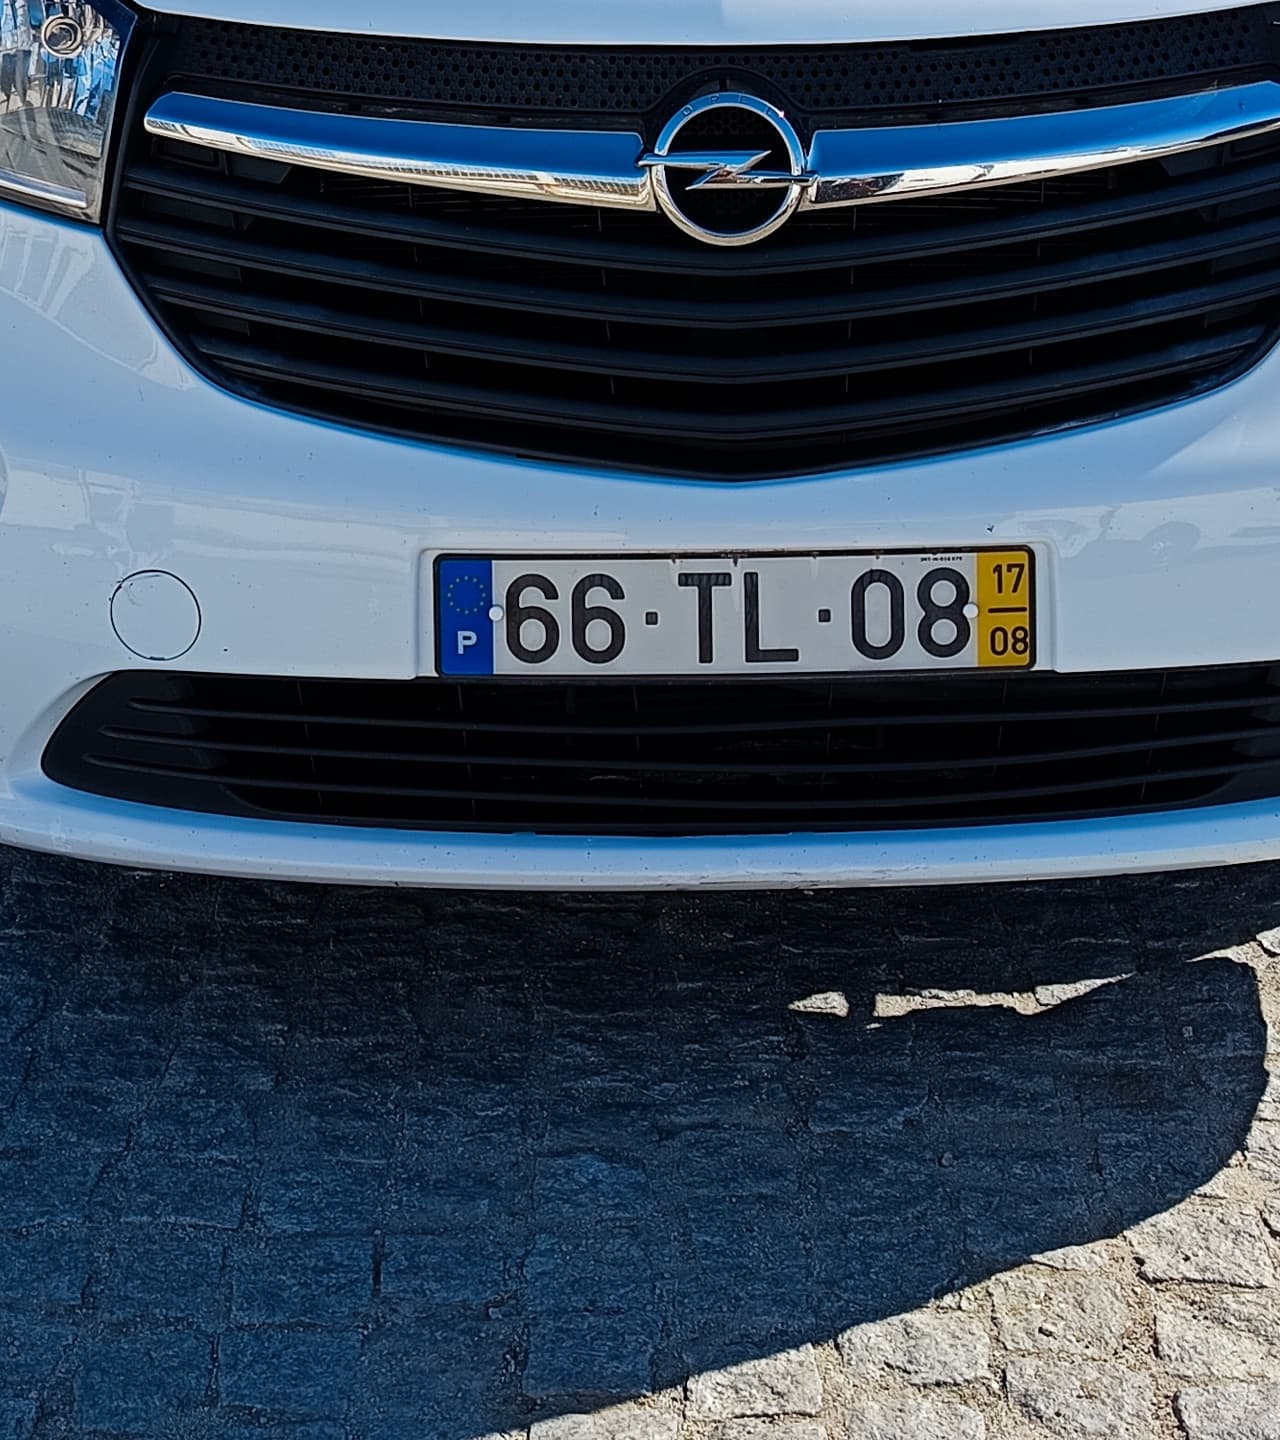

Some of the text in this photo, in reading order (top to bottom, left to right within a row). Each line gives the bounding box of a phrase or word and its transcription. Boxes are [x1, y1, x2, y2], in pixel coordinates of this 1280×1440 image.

[992, 563, 1025, 595] 17
[457, 630, 478, 655] P
[990, 626, 1029, 656] 08
